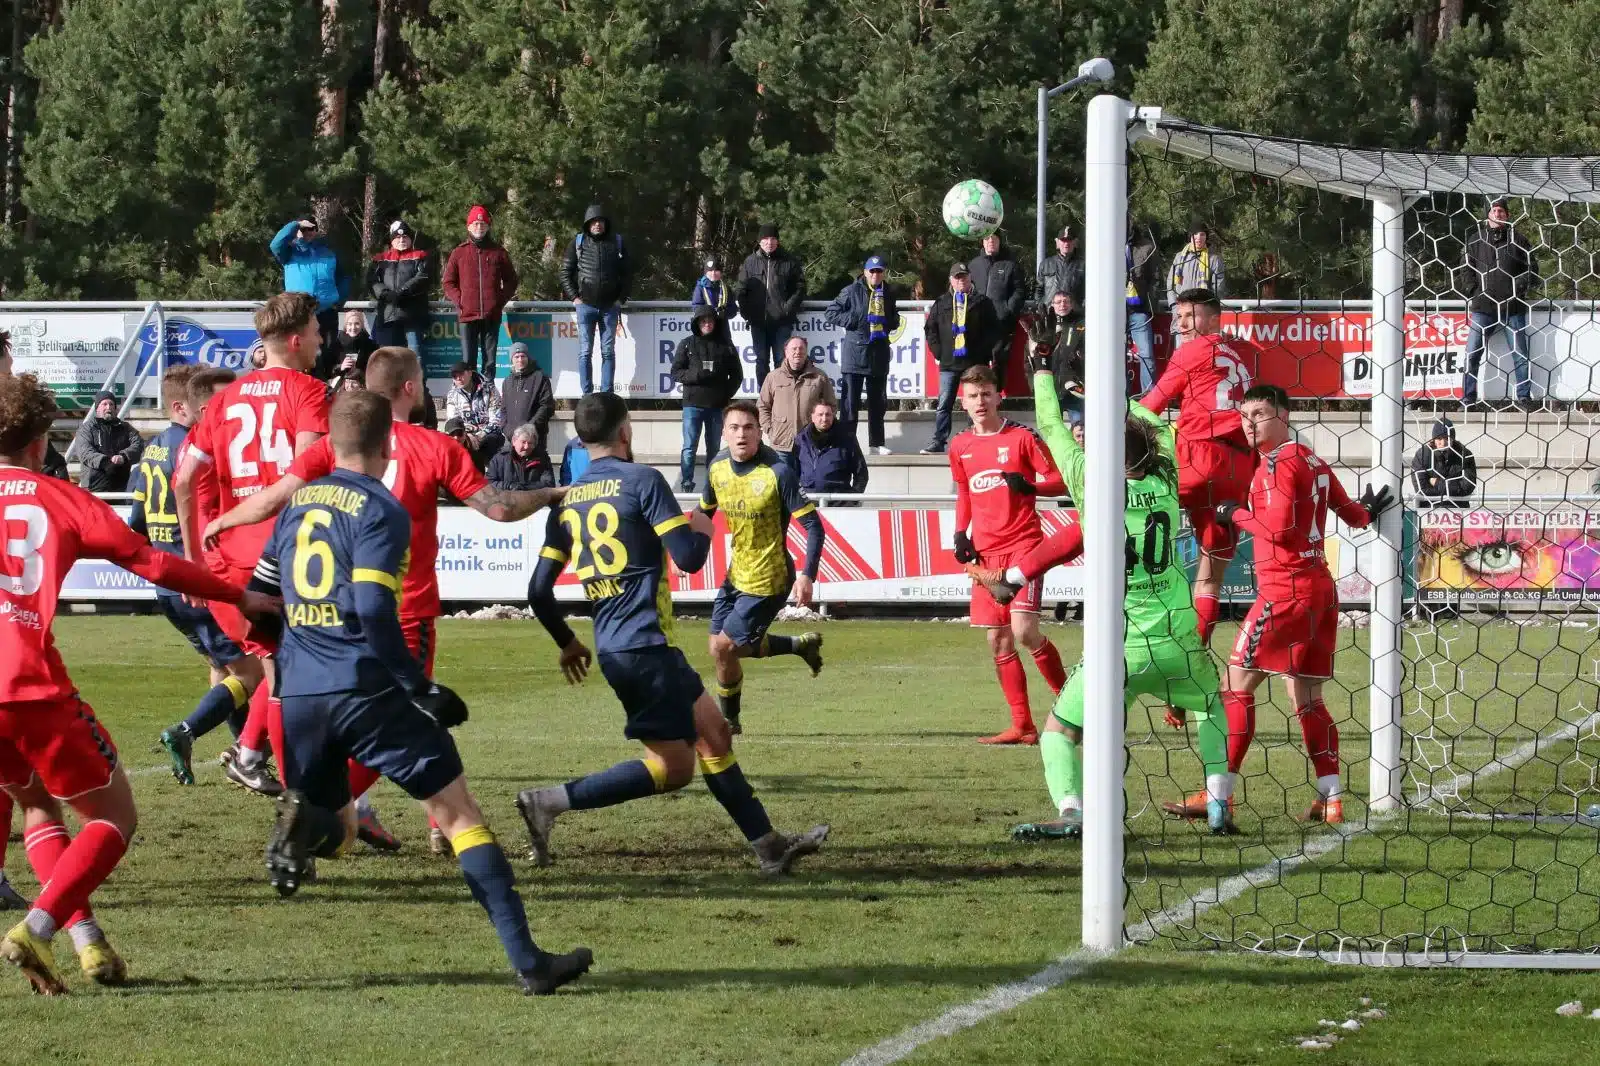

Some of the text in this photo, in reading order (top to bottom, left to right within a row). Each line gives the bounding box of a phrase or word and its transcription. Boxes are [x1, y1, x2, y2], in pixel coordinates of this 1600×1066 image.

[226, 402, 294, 478] 24
[1426, 512, 1463, 526] DAS
[1468, 512, 1540, 526] SYSTEM
[485, 533, 523, 549] und
[559, 502, 628, 581] 28
[292, 508, 336, 601] 6
[487, 561, 523, 571] GmbH
[911, 587, 965, 597] FLIESEN
[1427, 591, 1444, 599] ESB
[1446, 591, 1475, 599] Schulte
[1513, 591, 1526, 599] Co.
[1528, 591, 1541, 599] KG
